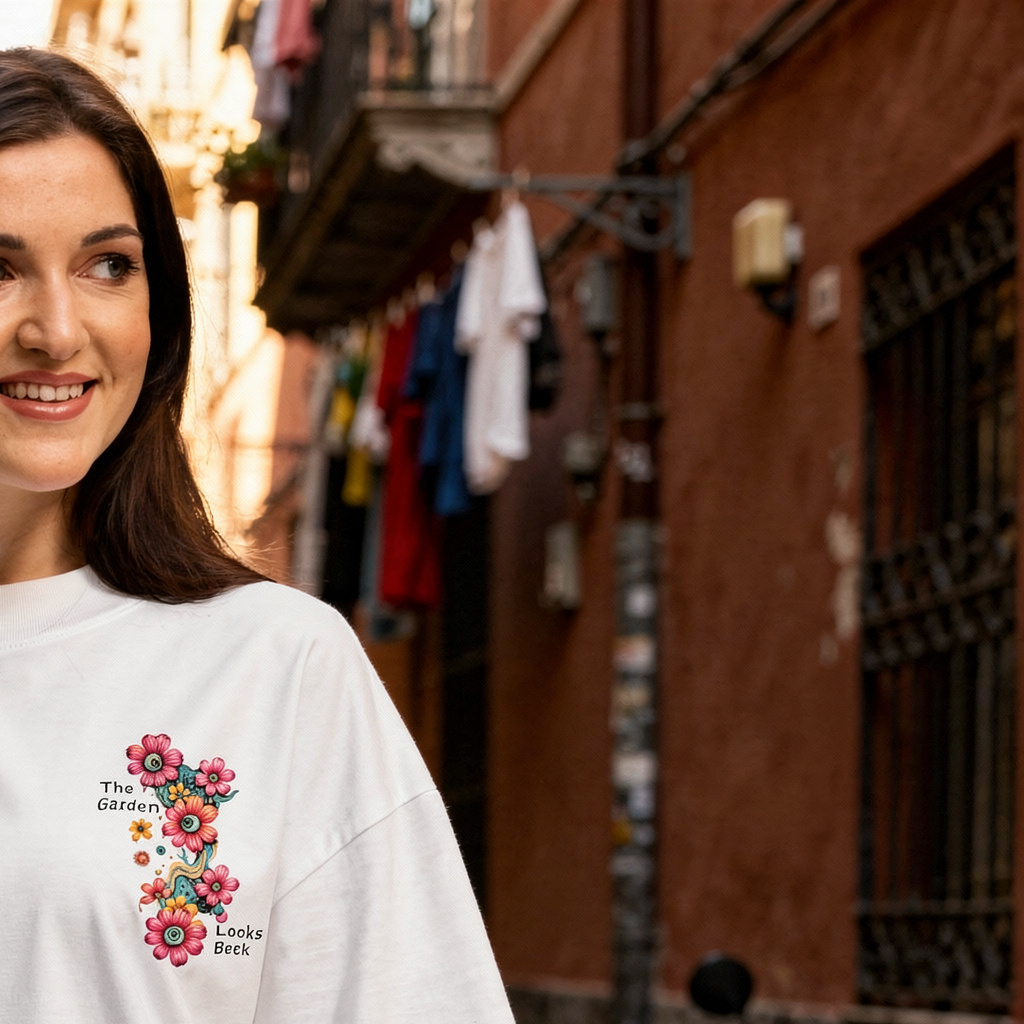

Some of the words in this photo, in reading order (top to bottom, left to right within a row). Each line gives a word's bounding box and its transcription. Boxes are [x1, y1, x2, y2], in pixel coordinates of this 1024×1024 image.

[99, 781, 134, 794] The
[97, 797, 160, 813] Garden
[216, 924, 263, 940] Looks
